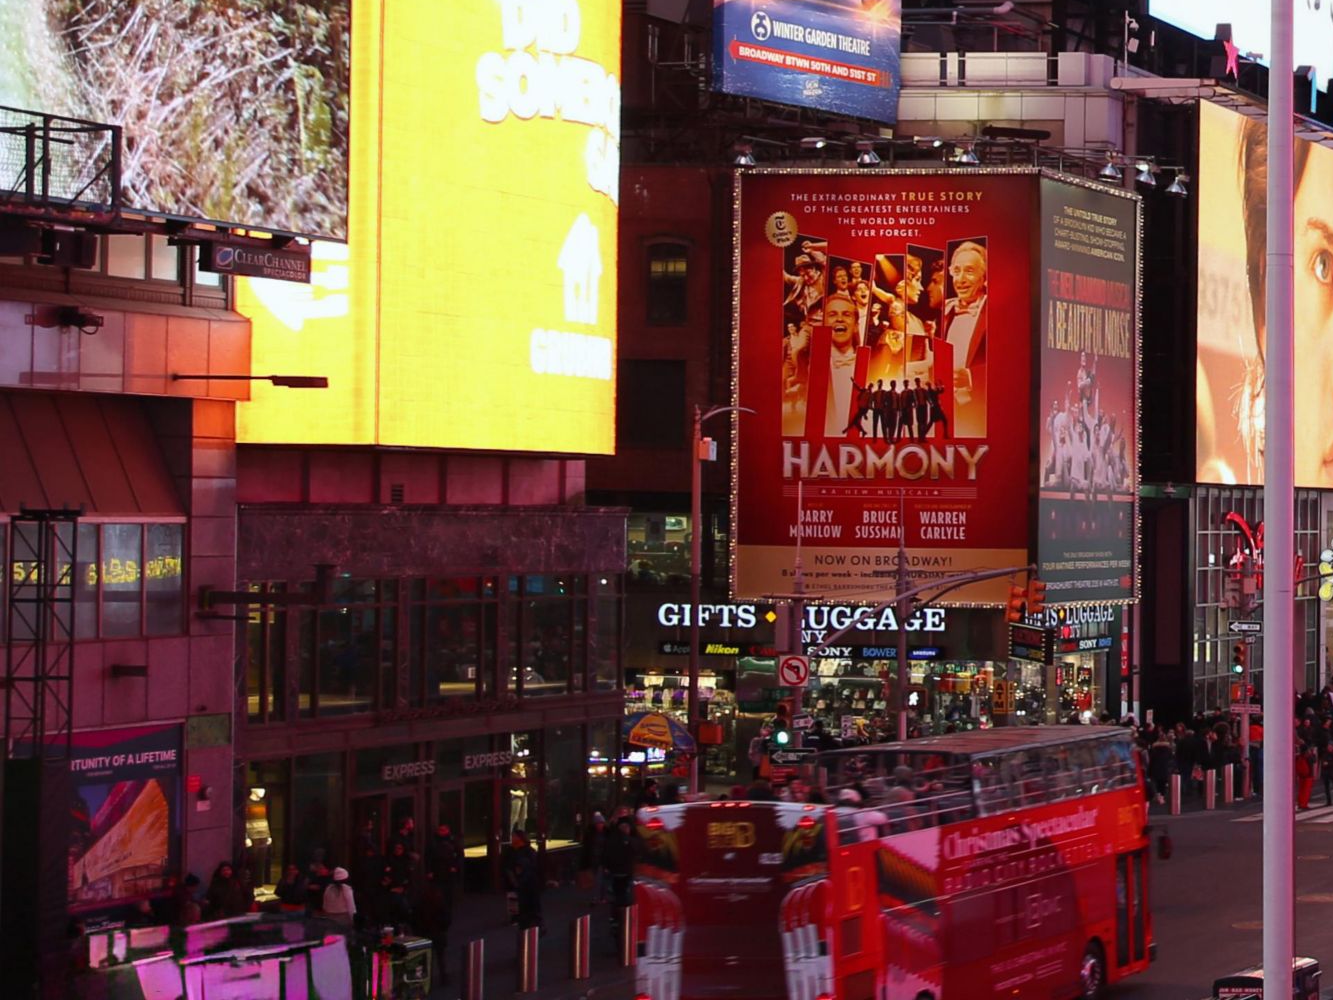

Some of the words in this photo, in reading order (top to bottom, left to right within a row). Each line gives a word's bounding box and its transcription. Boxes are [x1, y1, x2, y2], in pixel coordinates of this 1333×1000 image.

[773, 20, 804, 43] WINTER
[805, 29, 837, 50] GARDEN
[838, 35, 871, 57] THEATRE
[739, 46, 785, 64] BROADWAY
[785, 55, 809, 69] BTWN
[811, 62, 831, 73] 50TH
[832, 66, 849, 77] AND
[849, 70, 866, 81] 51ST
[867, 73, 876, 82] ST
[901, 192, 935, 201] TRUE
[940, 192, 983, 201] STORY
[821, 205, 839, 213] THE
[843, 205, 892, 213] GREATEST
[896, 205, 970, 213] ENTERTAINERS
[860, 217, 895, 225] WORLD
[900, 217, 936, 225] WOULD
[851, 229, 876, 237] EVER
[879, 229, 922, 237] FORGET.
[1048, 299, 1054, 349] A
[1056, 301, 1103, 356] BEAUTIFUL
[1105, 309, 1131, 359] NOISE
[782, 441, 989, 481] HARMONY
[877, 487, 930, 495] MUSICAL
[863, 511, 898, 524] BRUCE
[919, 512, 966, 525] WARREN
[920, 526, 966, 540] CARLYLE
[815, 555, 847, 566] NOW
[850, 555, 871, 566] ON
[875, 555, 952, 567] BROADWAY!
[815, 571, 829, 580] per
[658, 604, 757, 628] GIFTS
[801, 605, 946, 631] UGGAGE
[1066, 604, 1114, 624] LUGGAGE
[705, 644, 739, 655] Nikon
[807, 647, 852, 656] SONY
[862, 647, 897, 658] BOWER
[1079, 640, 1097, 649] SONY
[994, 682, 1005, 709] ATM
[112, 754, 125, 766] OF
[126, 754, 134, 765] A
[136, 749, 177, 764] LIFETIME
[463, 750, 513, 770] EXPRESS
[383, 760, 435, 780] EXPRESS
[944, 826, 1021, 861] Christmas
[1020, 806, 1099, 851] Spectacular
